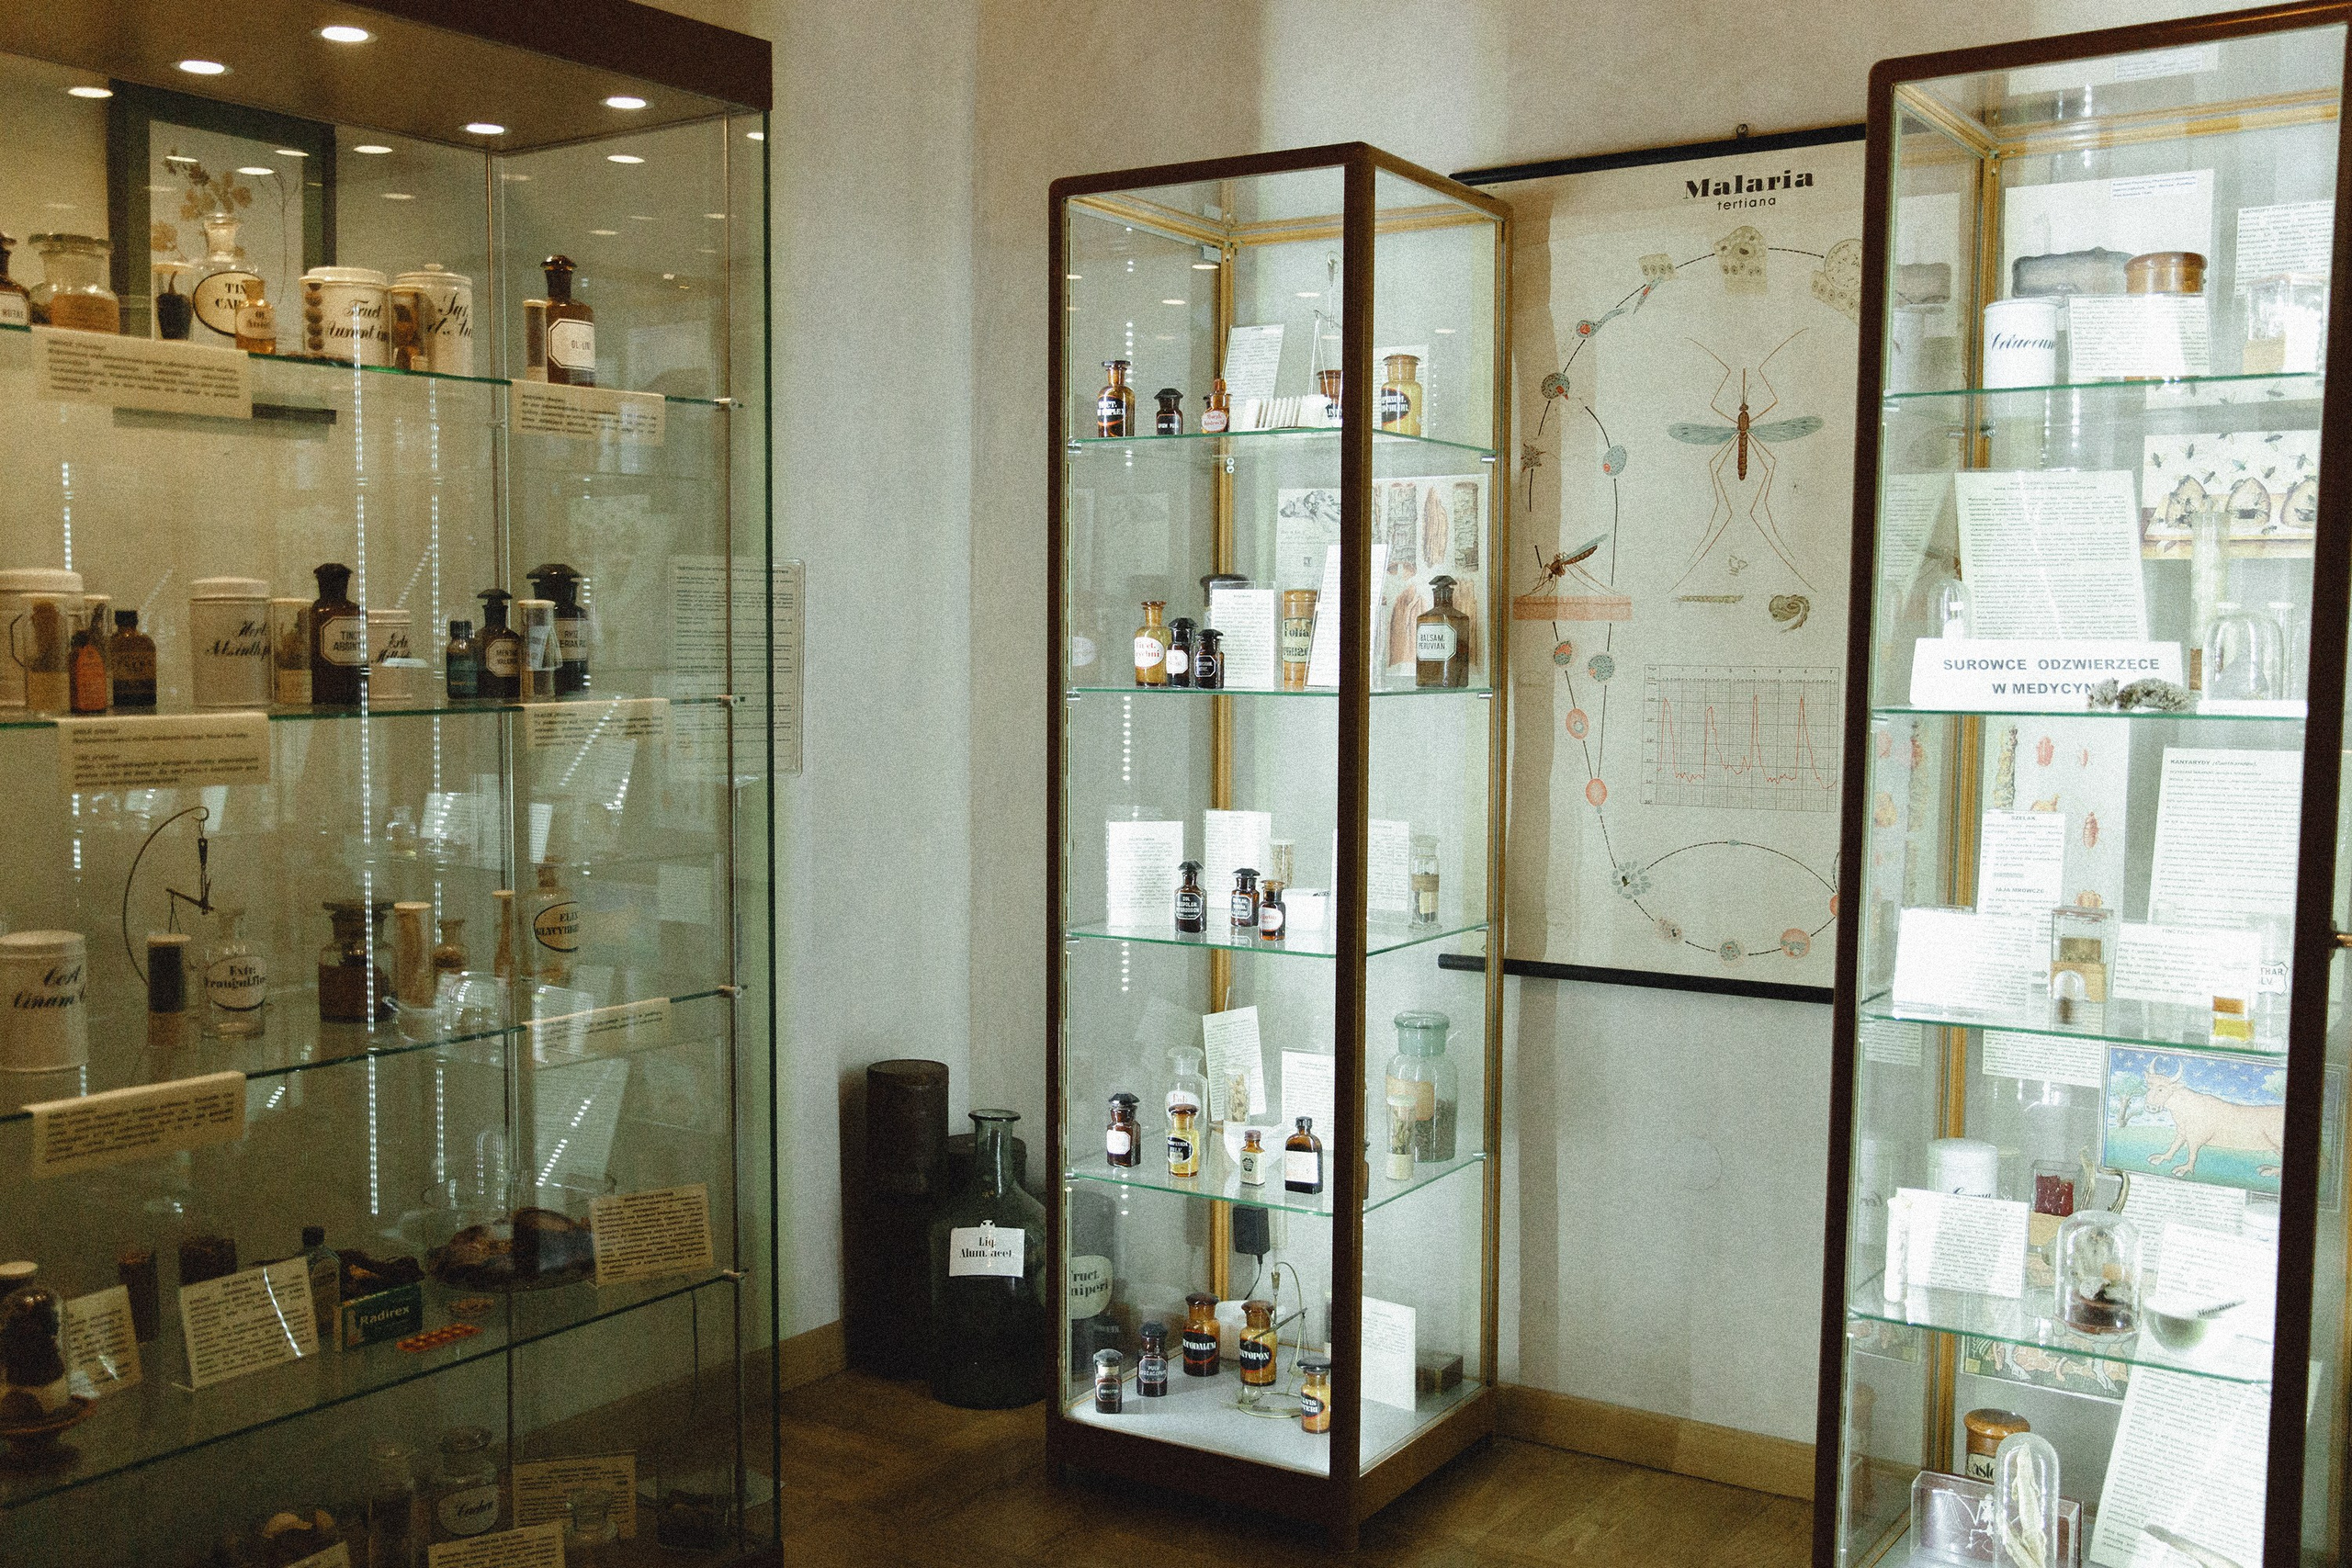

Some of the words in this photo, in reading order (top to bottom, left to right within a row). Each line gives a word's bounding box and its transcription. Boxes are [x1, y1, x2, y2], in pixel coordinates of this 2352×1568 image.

[1683, 169, 1814, 200] Malaria
[1717, 196, 1777, 211] tertiana
[1943, 659, 2027, 671] SUROWCE
[2038, 659, 2159, 673] ODZWIERZĘCE
[1992, 682, 2007, 694] W
[2012, 682, 2096, 694] MEDYCYN
[959, 1248, 988, 1259] Alum.
[1070, 1269, 1100, 1282] ruct.
[360, 1305, 410, 1325] Radirex
